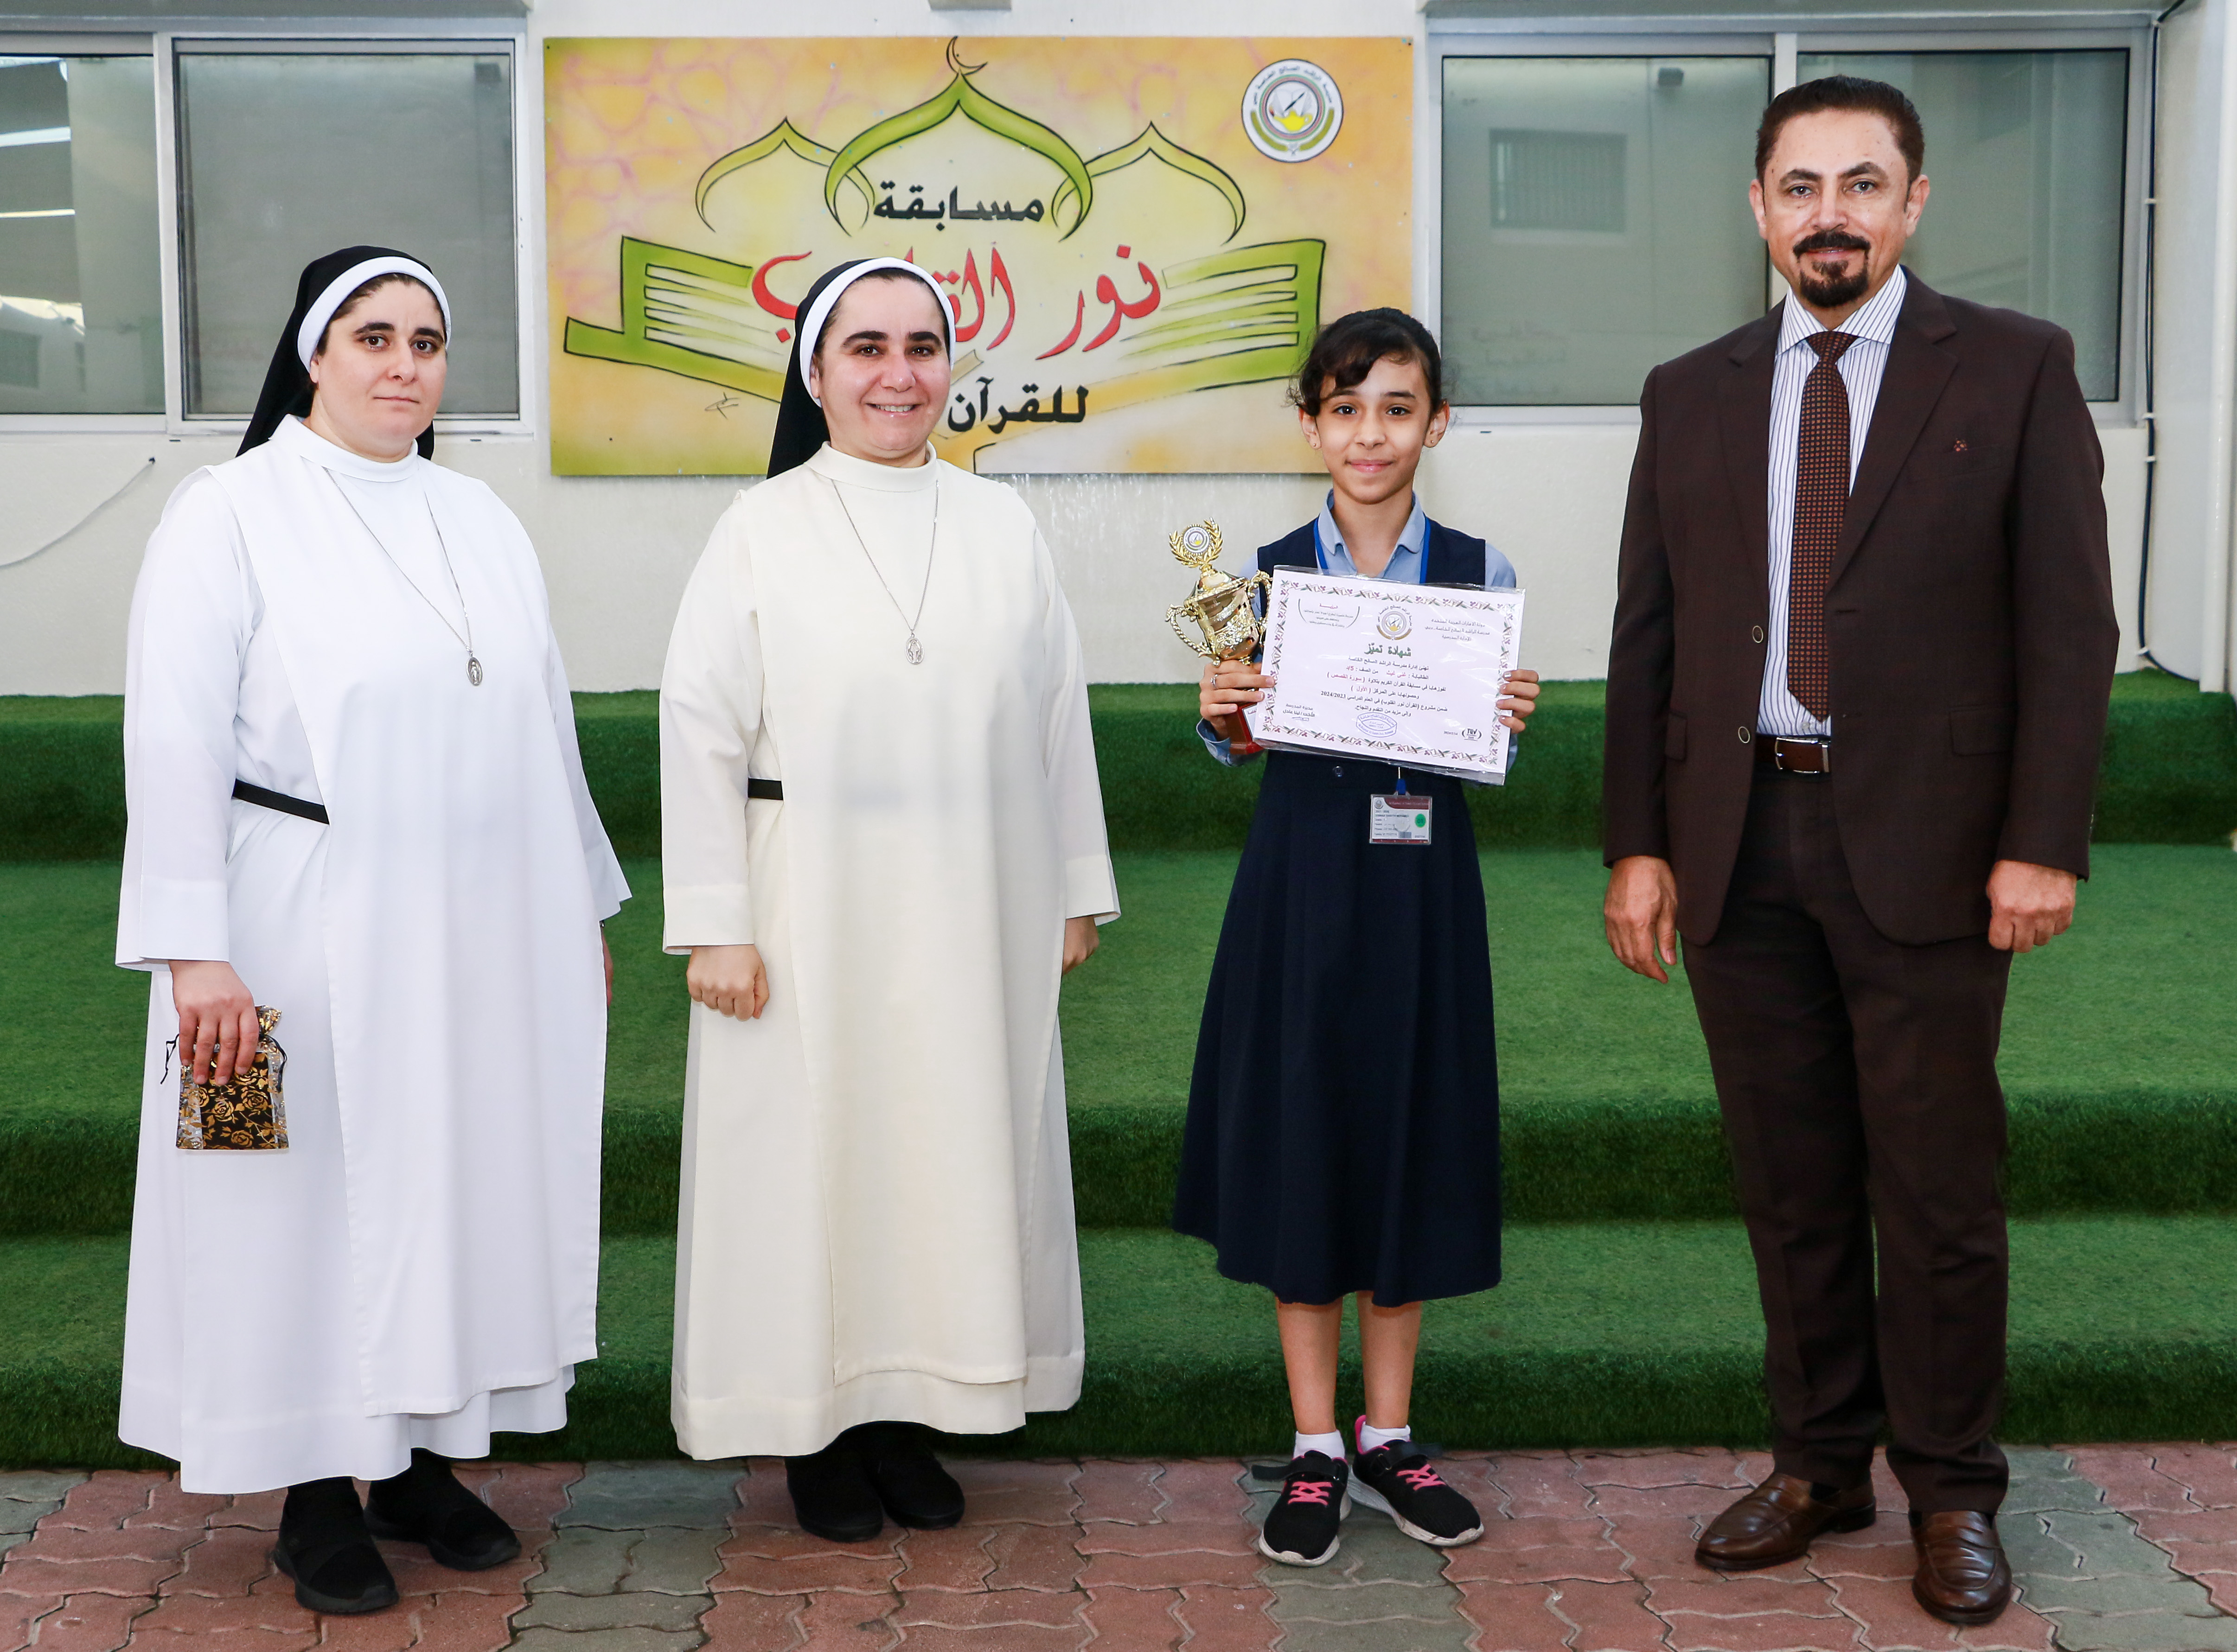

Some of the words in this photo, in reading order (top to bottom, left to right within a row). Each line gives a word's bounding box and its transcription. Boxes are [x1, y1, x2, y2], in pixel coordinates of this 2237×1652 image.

[873, 180, 1044, 231] مسابقة
[751, 246, 1016, 351] القب
[1035, 245, 1162, 361] نور
[947, 376, 1089, 434] للقرآن
[1388, 645, 1411, 658] شهادة
